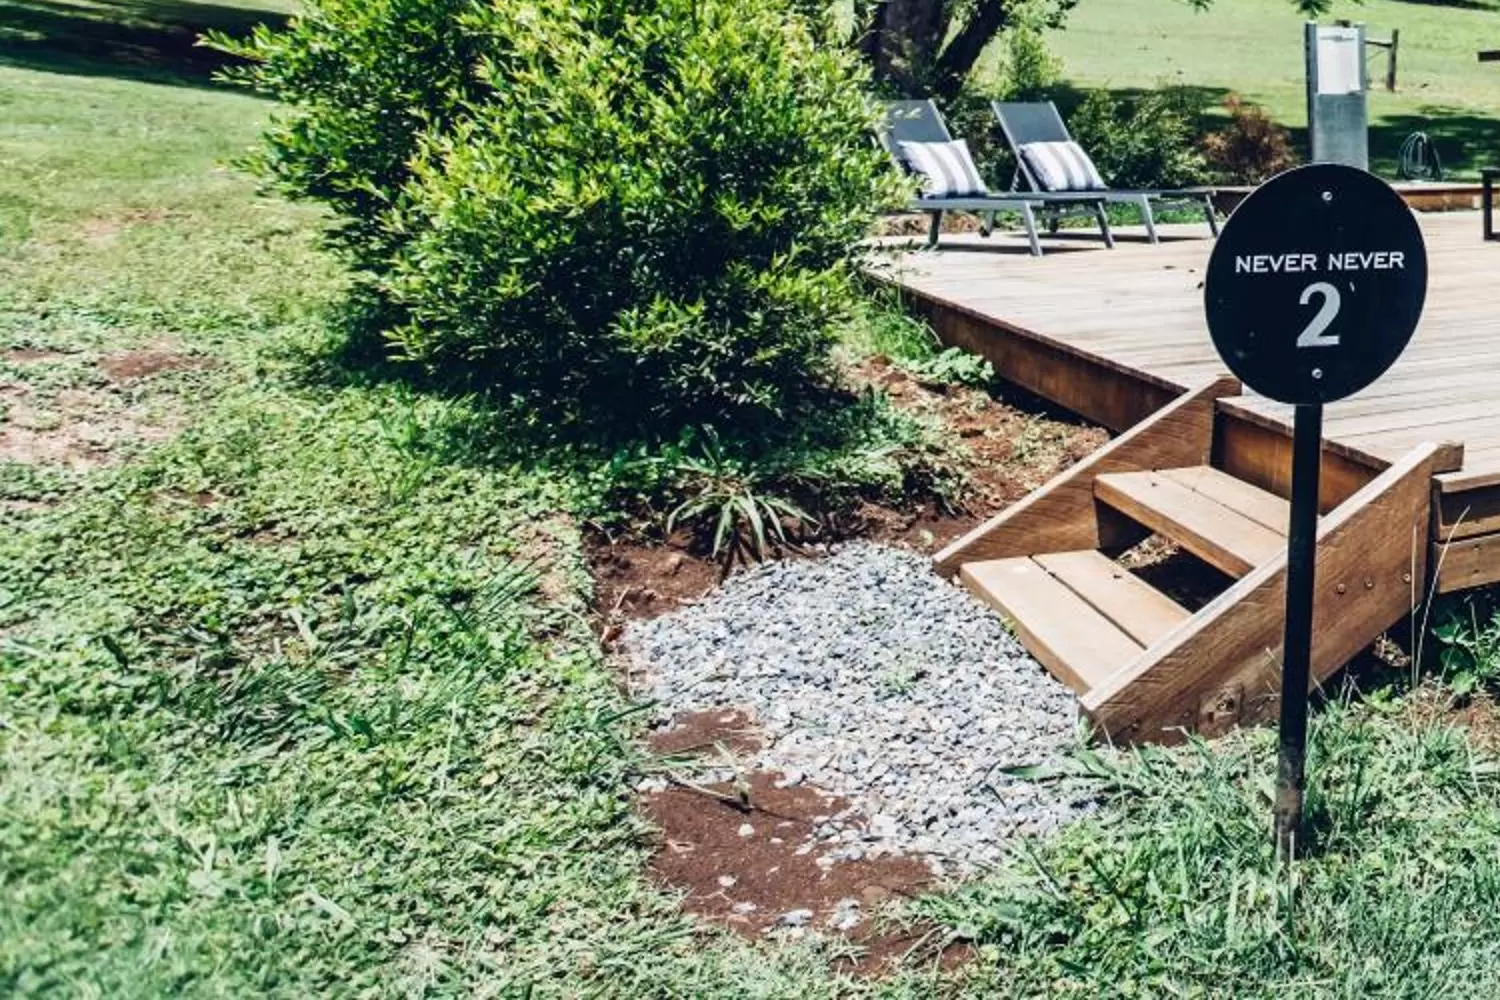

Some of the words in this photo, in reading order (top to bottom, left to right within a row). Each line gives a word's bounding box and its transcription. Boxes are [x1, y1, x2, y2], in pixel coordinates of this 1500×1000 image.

[1235, 254, 1317, 273] NEVER
[1328, 251, 1405, 270] NEVER
[1296, 281, 1341, 348] 2
